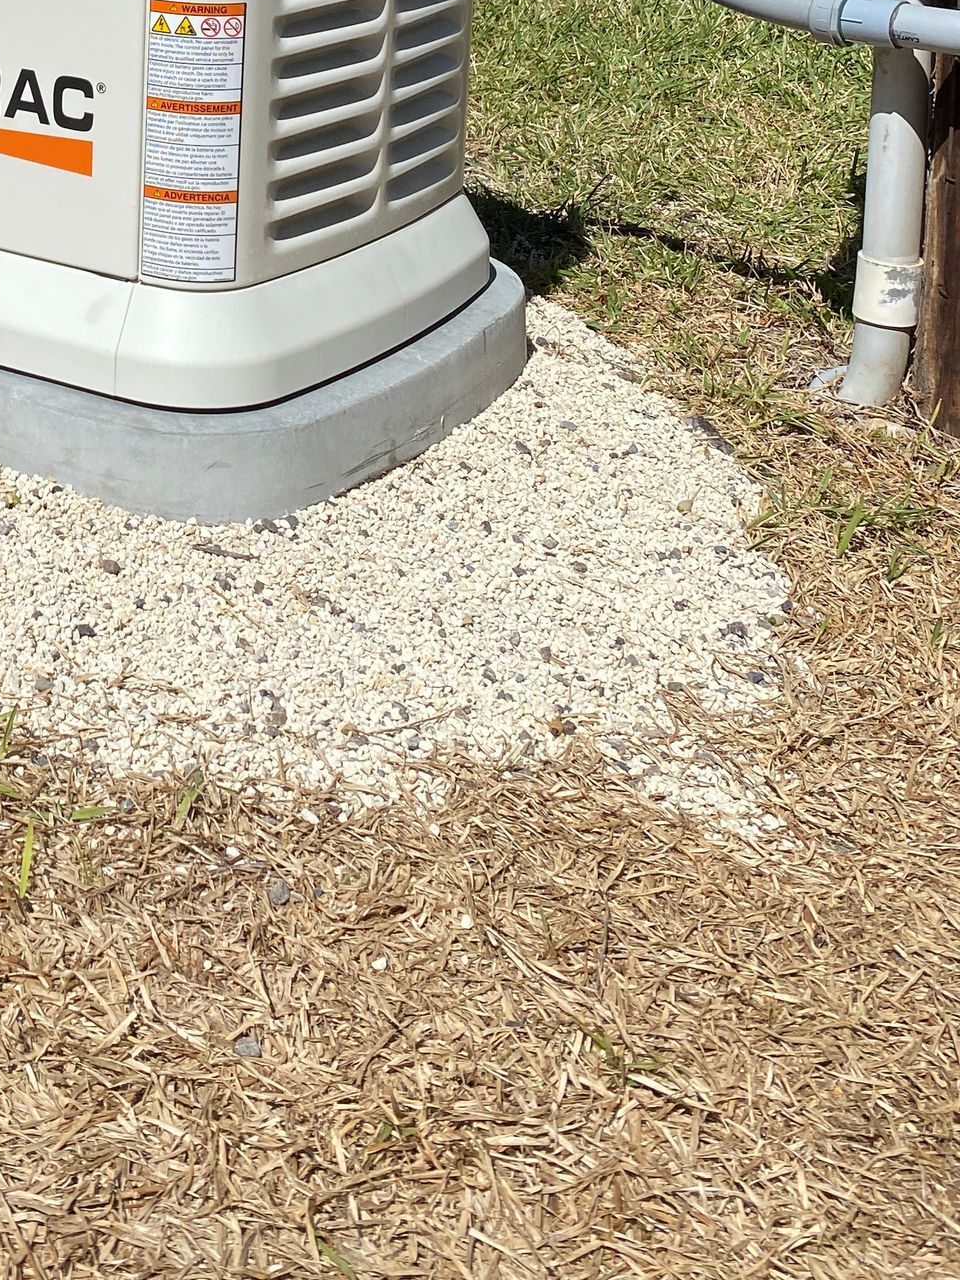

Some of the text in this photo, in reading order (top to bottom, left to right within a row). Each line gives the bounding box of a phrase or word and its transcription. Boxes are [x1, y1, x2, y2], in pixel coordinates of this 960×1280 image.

[182, 4, 228, 14] WARNING
[160, 102, 238, 113] AVERTISSEMENT
[164, 192, 230, 202] ADVERTENCIA
